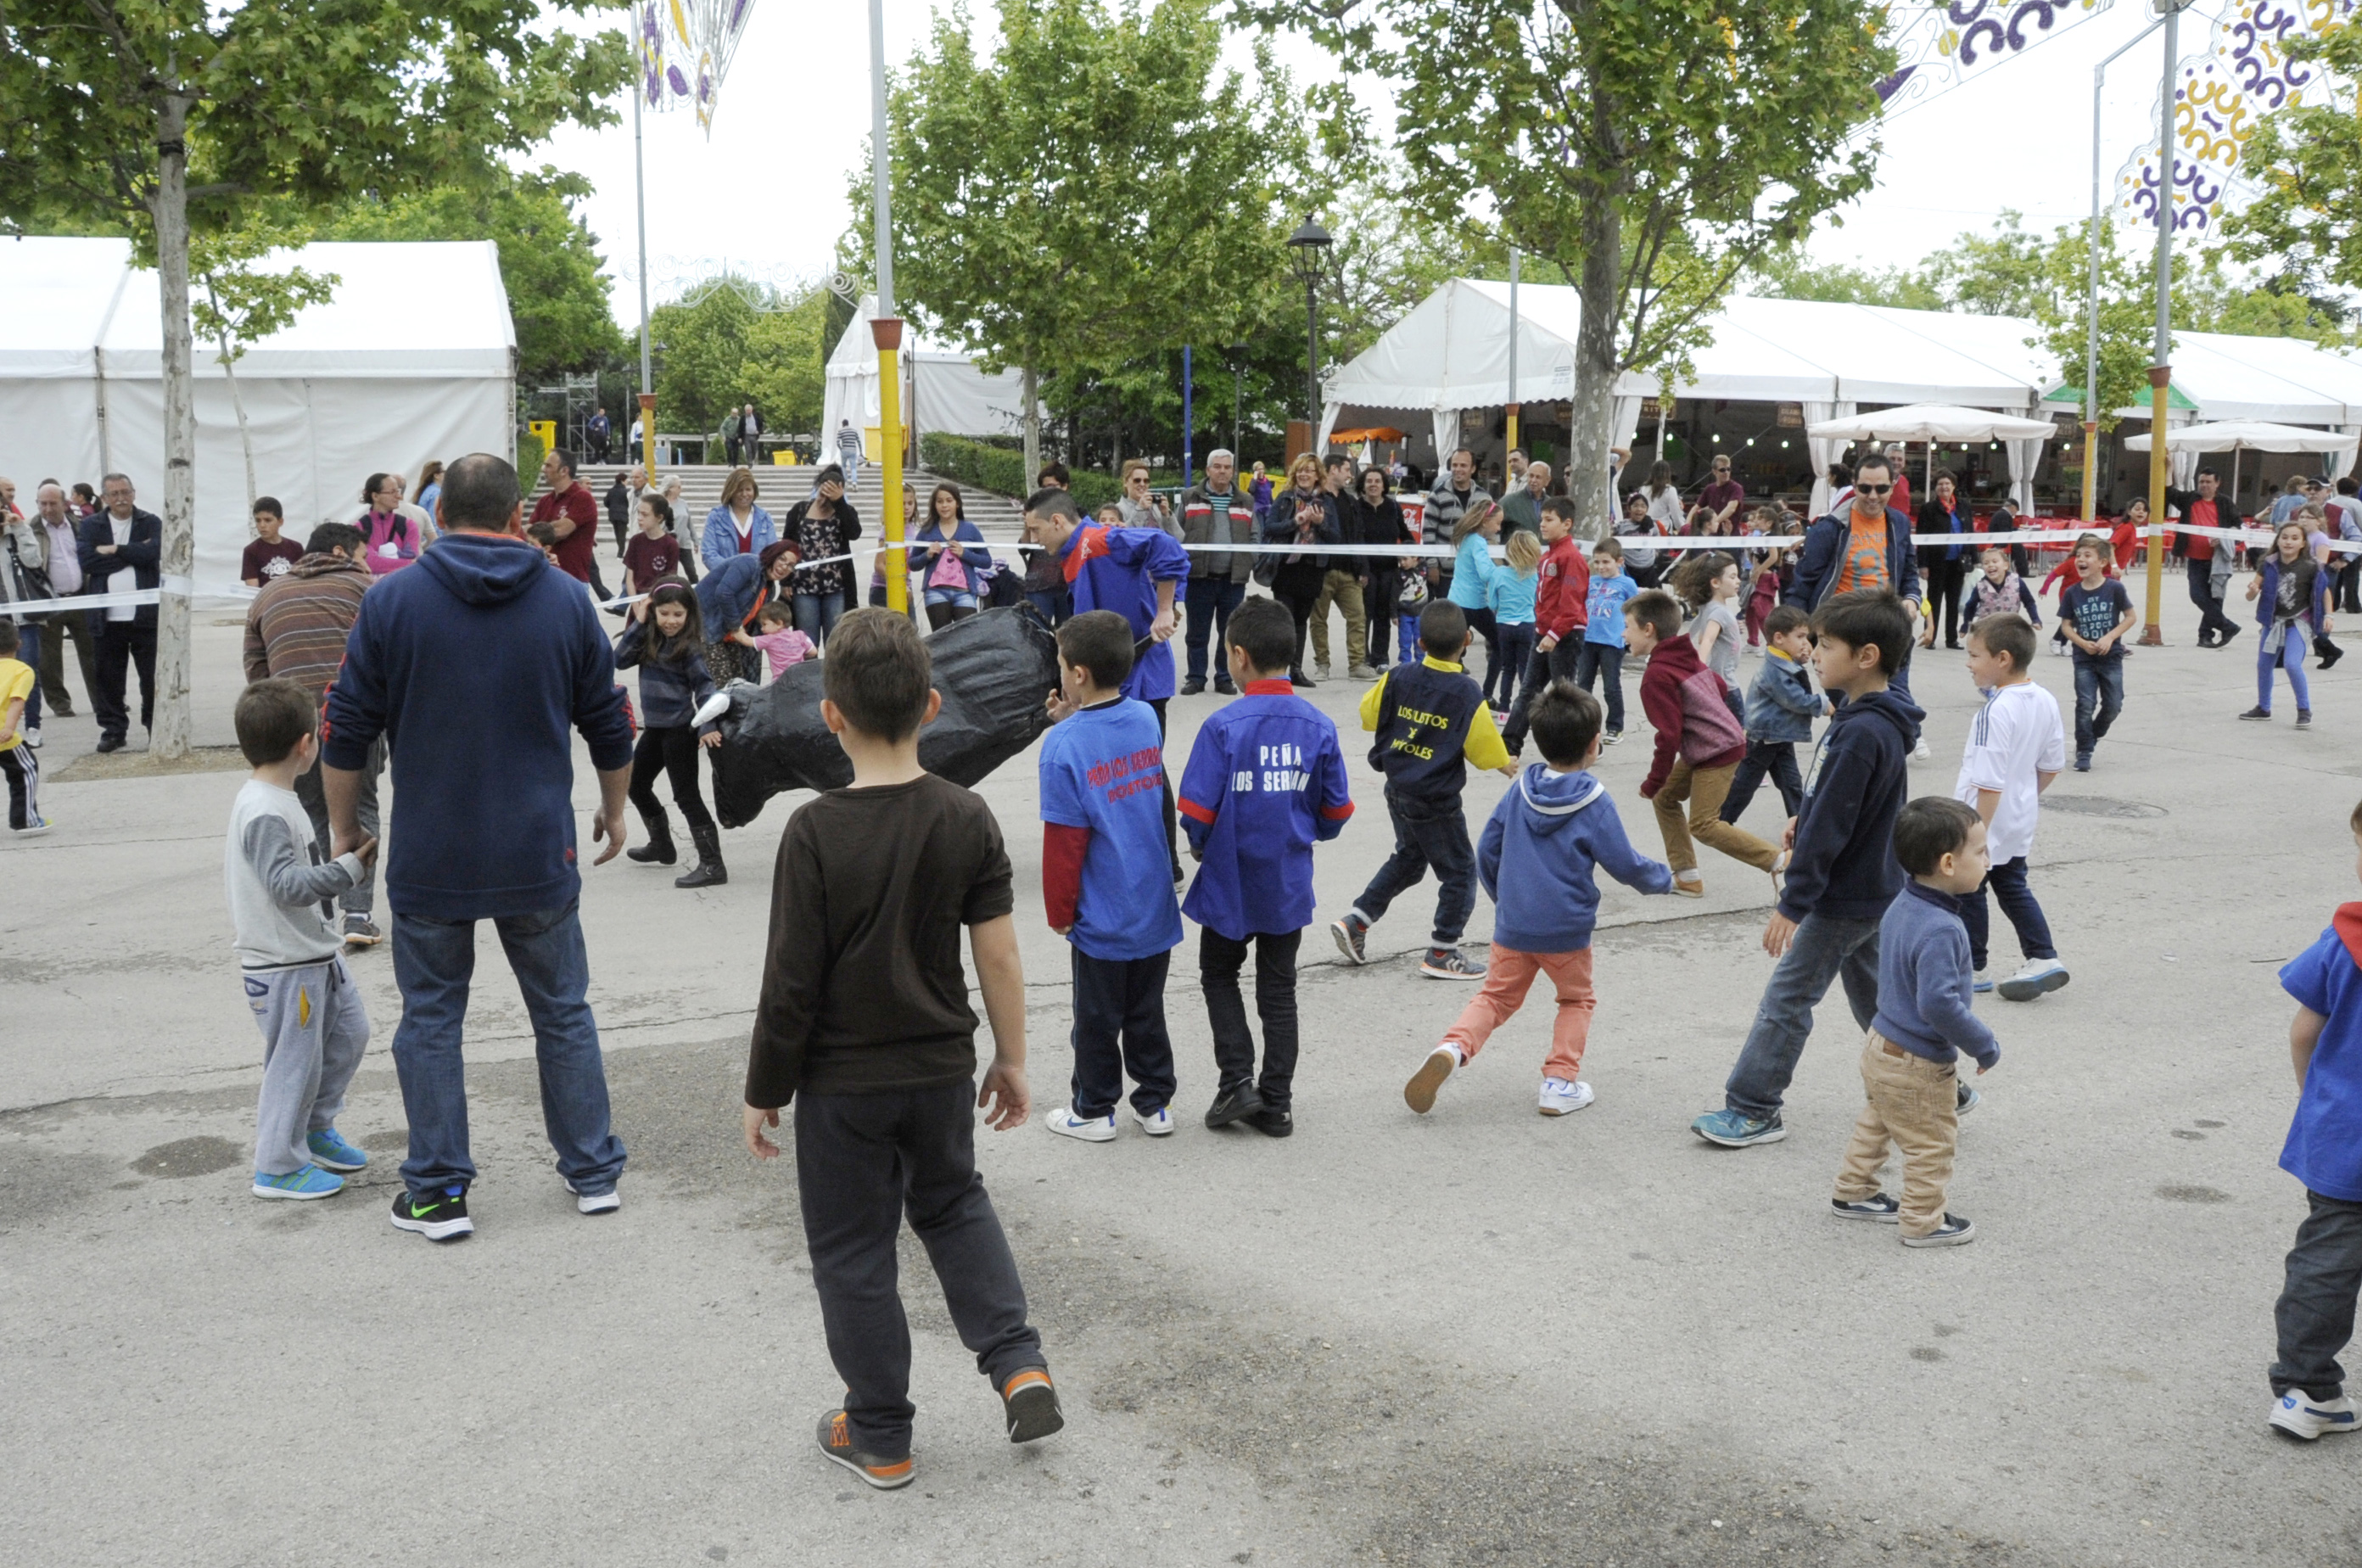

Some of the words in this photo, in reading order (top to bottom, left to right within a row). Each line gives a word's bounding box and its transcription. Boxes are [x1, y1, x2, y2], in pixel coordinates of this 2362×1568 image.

[2074, 602, 2114, 617] HEART
[1397, 705, 1413, 720] LOS
[1260, 742, 1301, 766] PEÑA
[1231, 770, 1253, 792] LOS
